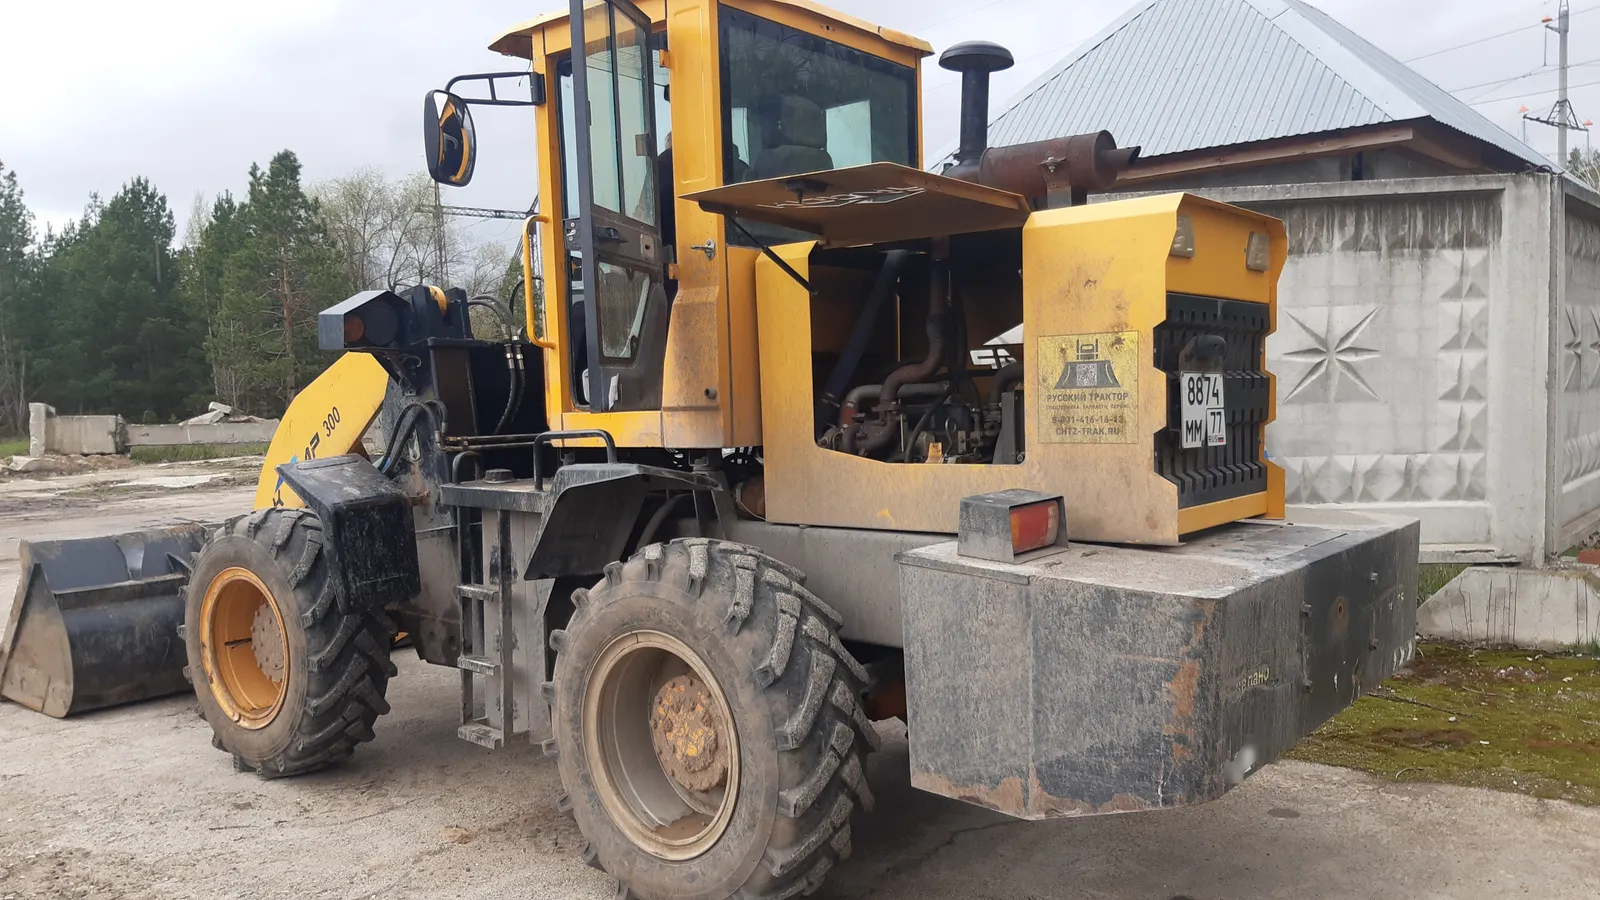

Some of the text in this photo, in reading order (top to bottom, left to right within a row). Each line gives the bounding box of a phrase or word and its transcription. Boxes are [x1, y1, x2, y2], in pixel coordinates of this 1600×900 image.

[1047, 392, 1129, 402] РУССКИЙ ТРАКТОР
[1187, 376, 1220, 406] 8874
[322, 406, 340, 438] 300
[1055, 427, 1120, 436] CHTZ-TRAK.RU
[1210, 411, 1222, 434] 77
